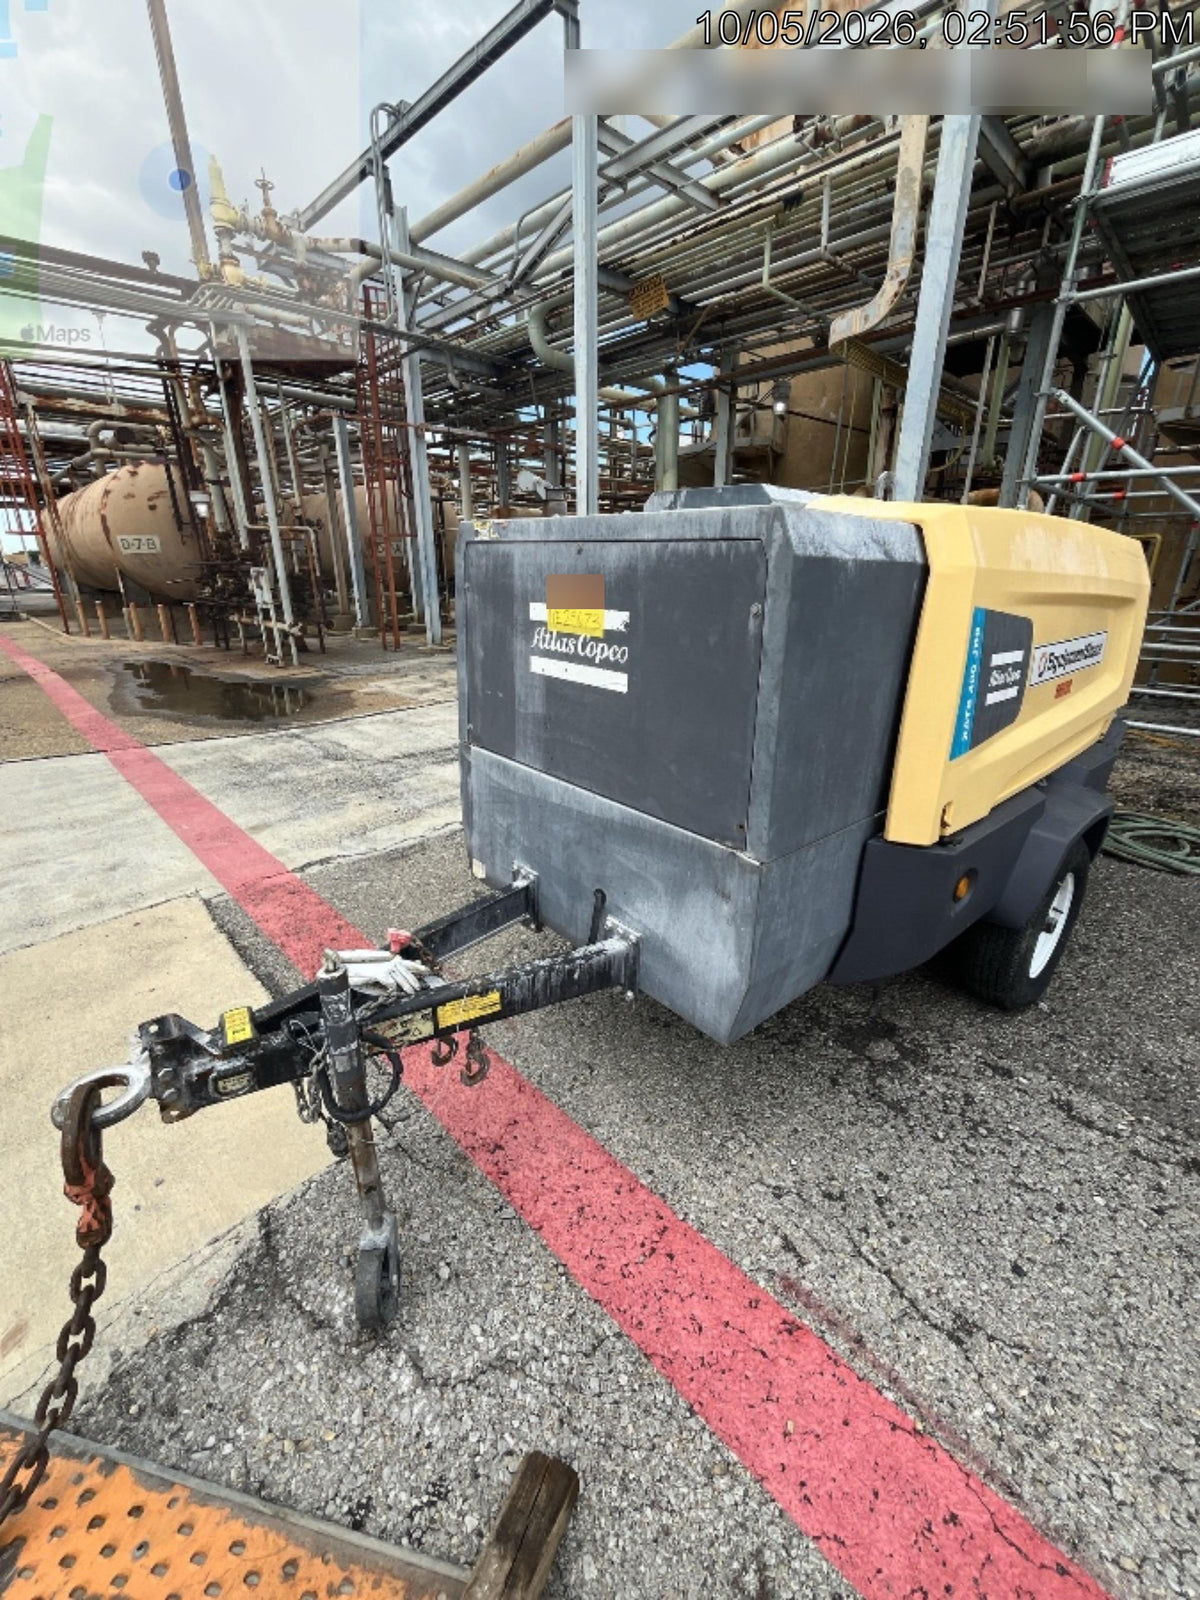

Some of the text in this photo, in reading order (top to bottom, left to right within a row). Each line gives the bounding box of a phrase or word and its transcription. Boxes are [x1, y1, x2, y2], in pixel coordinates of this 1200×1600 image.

[120, 538, 157, 550] D-7-B
[531, 627, 629, 663] Atlas Copco
